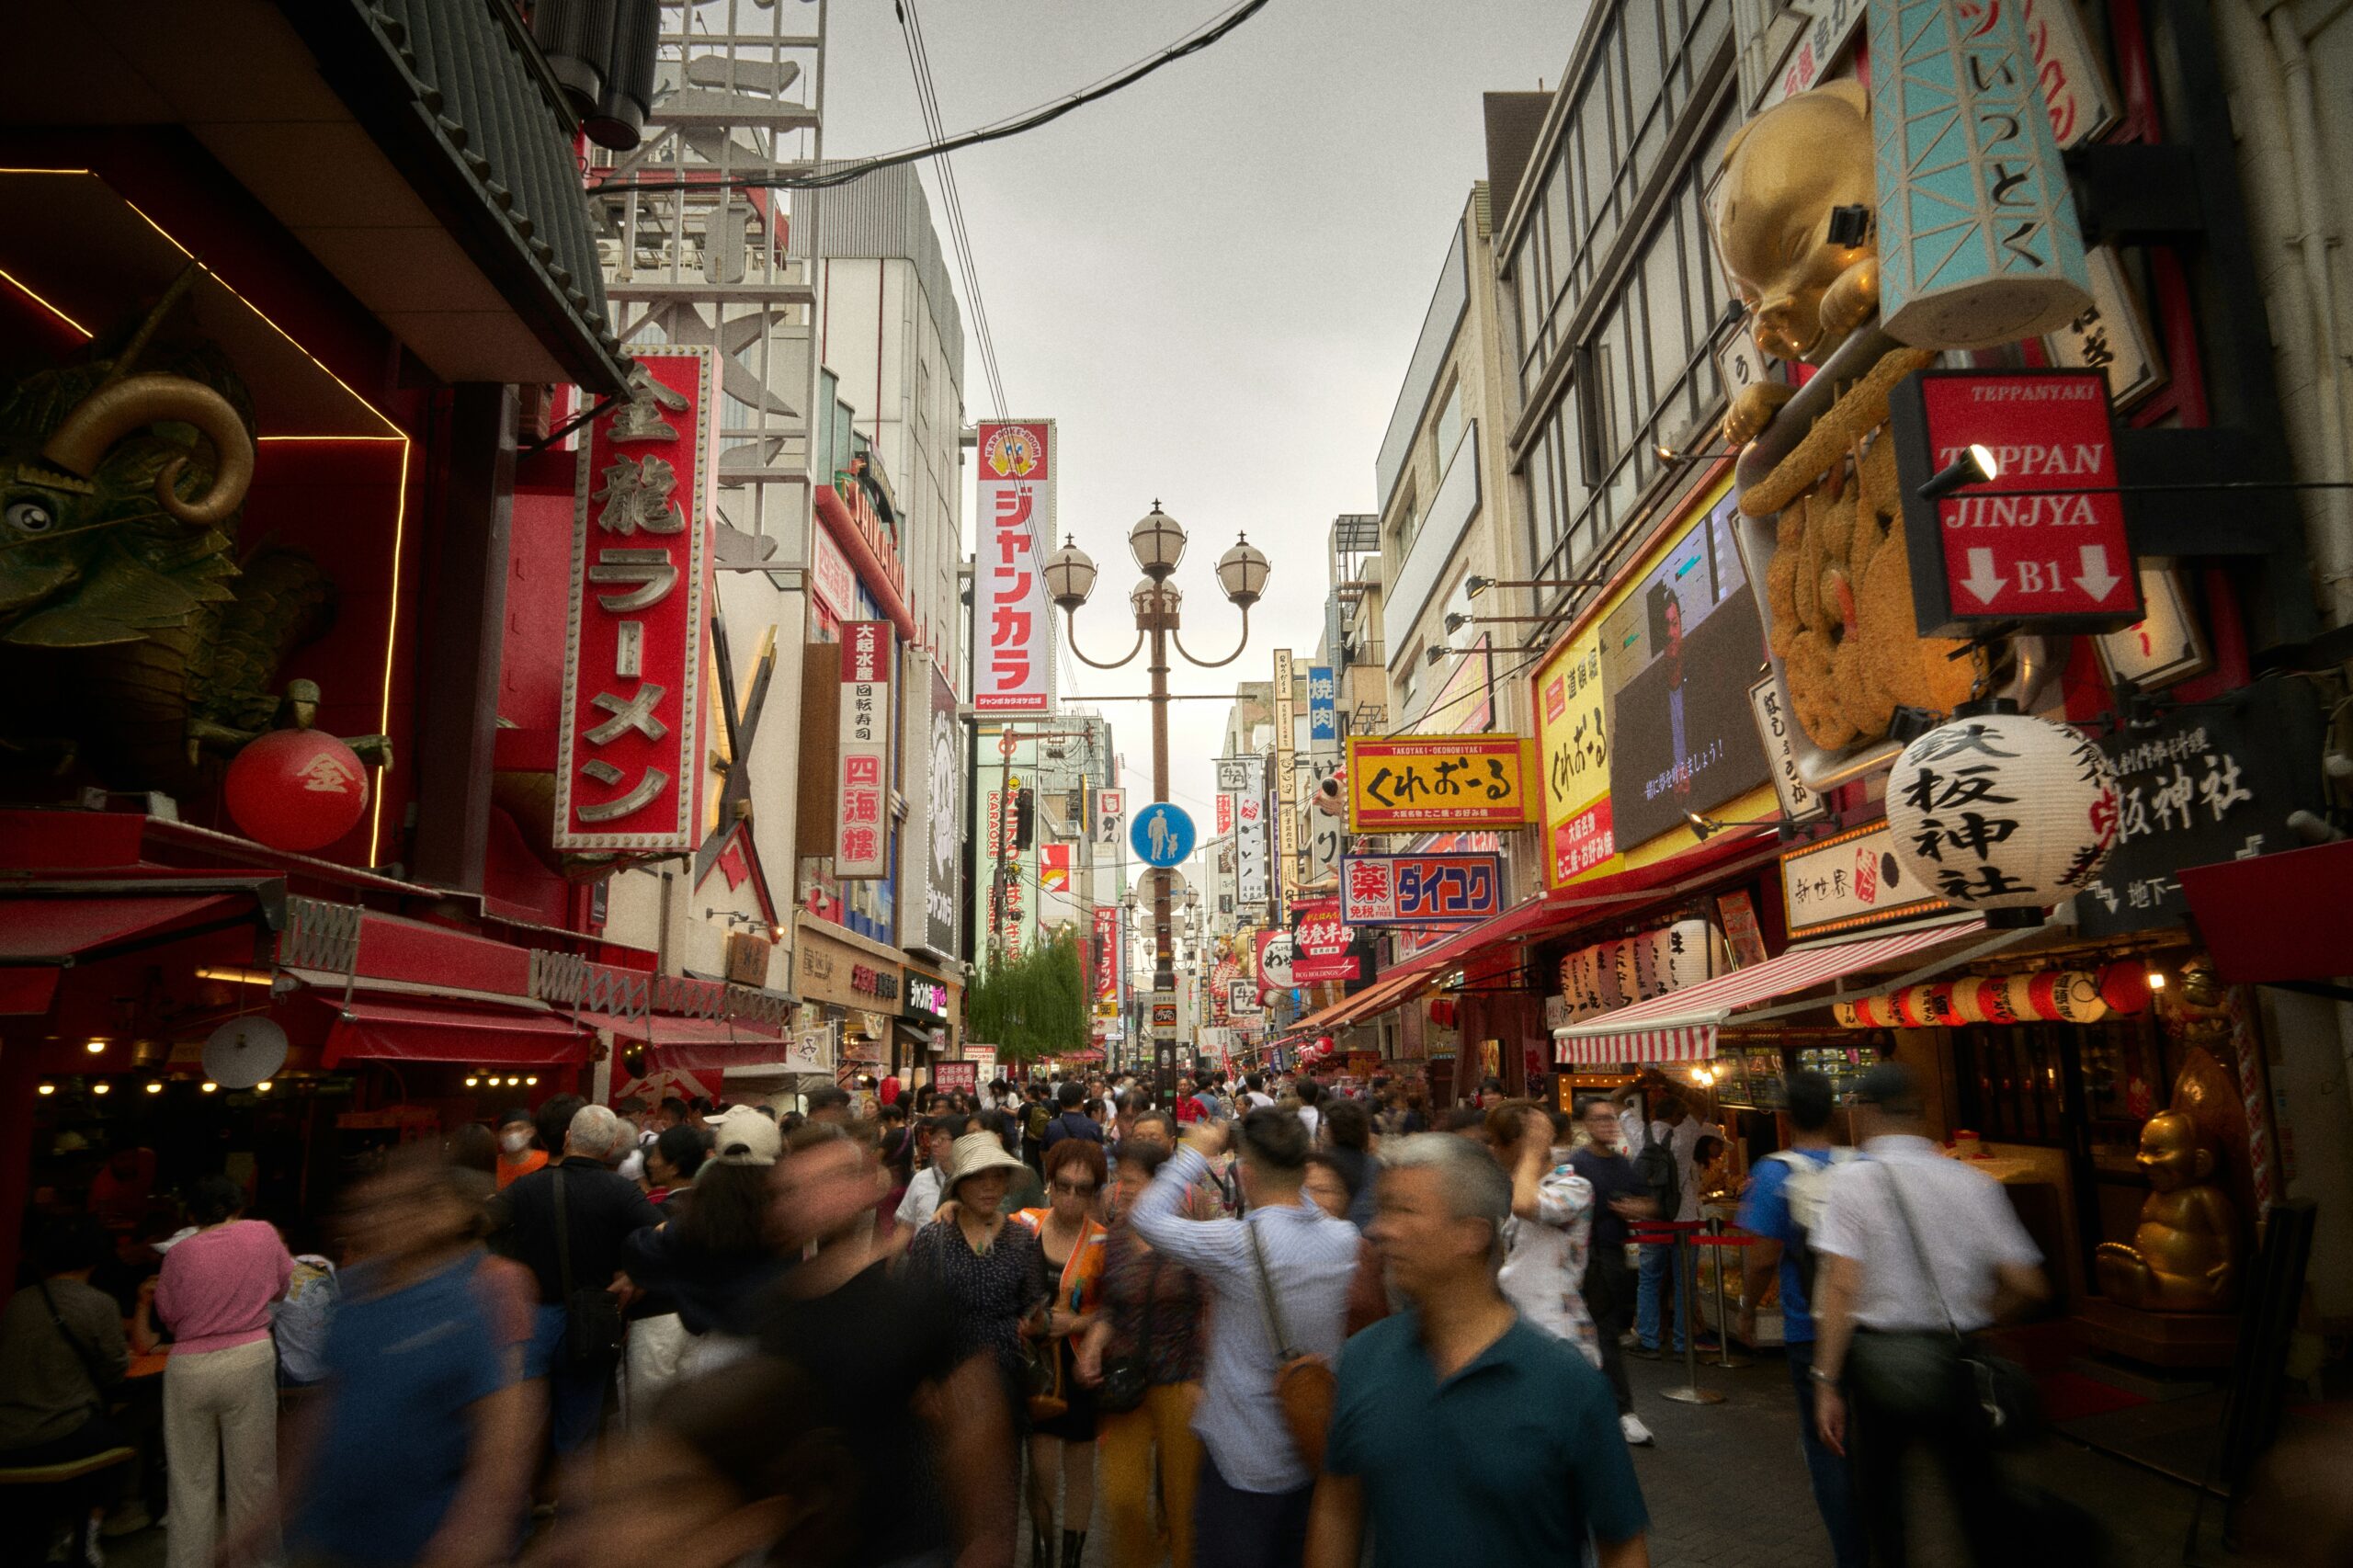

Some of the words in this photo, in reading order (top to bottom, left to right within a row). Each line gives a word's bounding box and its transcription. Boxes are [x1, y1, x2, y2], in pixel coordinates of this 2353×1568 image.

[1971, 383, 2096, 403] TEPPANYAKI
[1939, 443, 2104, 476] TPPAN
[1945, 494, 2098, 528] JINJYA
[576, 362, 691, 822] 金龍ラーメン
[991, 485, 1033, 691] ジャンカラ
[2015, 560, 2066, 594] B1
[855, 624, 875, 681] 大起水産
[855, 684, 872, 741] 回転寿司
[1310, 678, 1334, 729] 焼肉
[297, 753, 356, 793] 金
[1552, 707, 1608, 803] くれおーる
[1367, 756, 1512, 807] くれおーる
[988, 792, 999, 858] KARAOKE
[1392, 810, 1423, 818] 大阪名物
[1568, 811, 1596, 844] 大阪名物
[1903, 722, 2037, 903] 鉄板神社
[927, 881, 952, 926] ジャンカラ
[1348, 861, 1391, 903] 薬
[1398, 864, 1493, 913] ダイコク
[1795, 869, 1851, 905] 新世界
[1294, 922, 1355, 945] 能登半島
[1350, 905, 1374, 918] 免税
